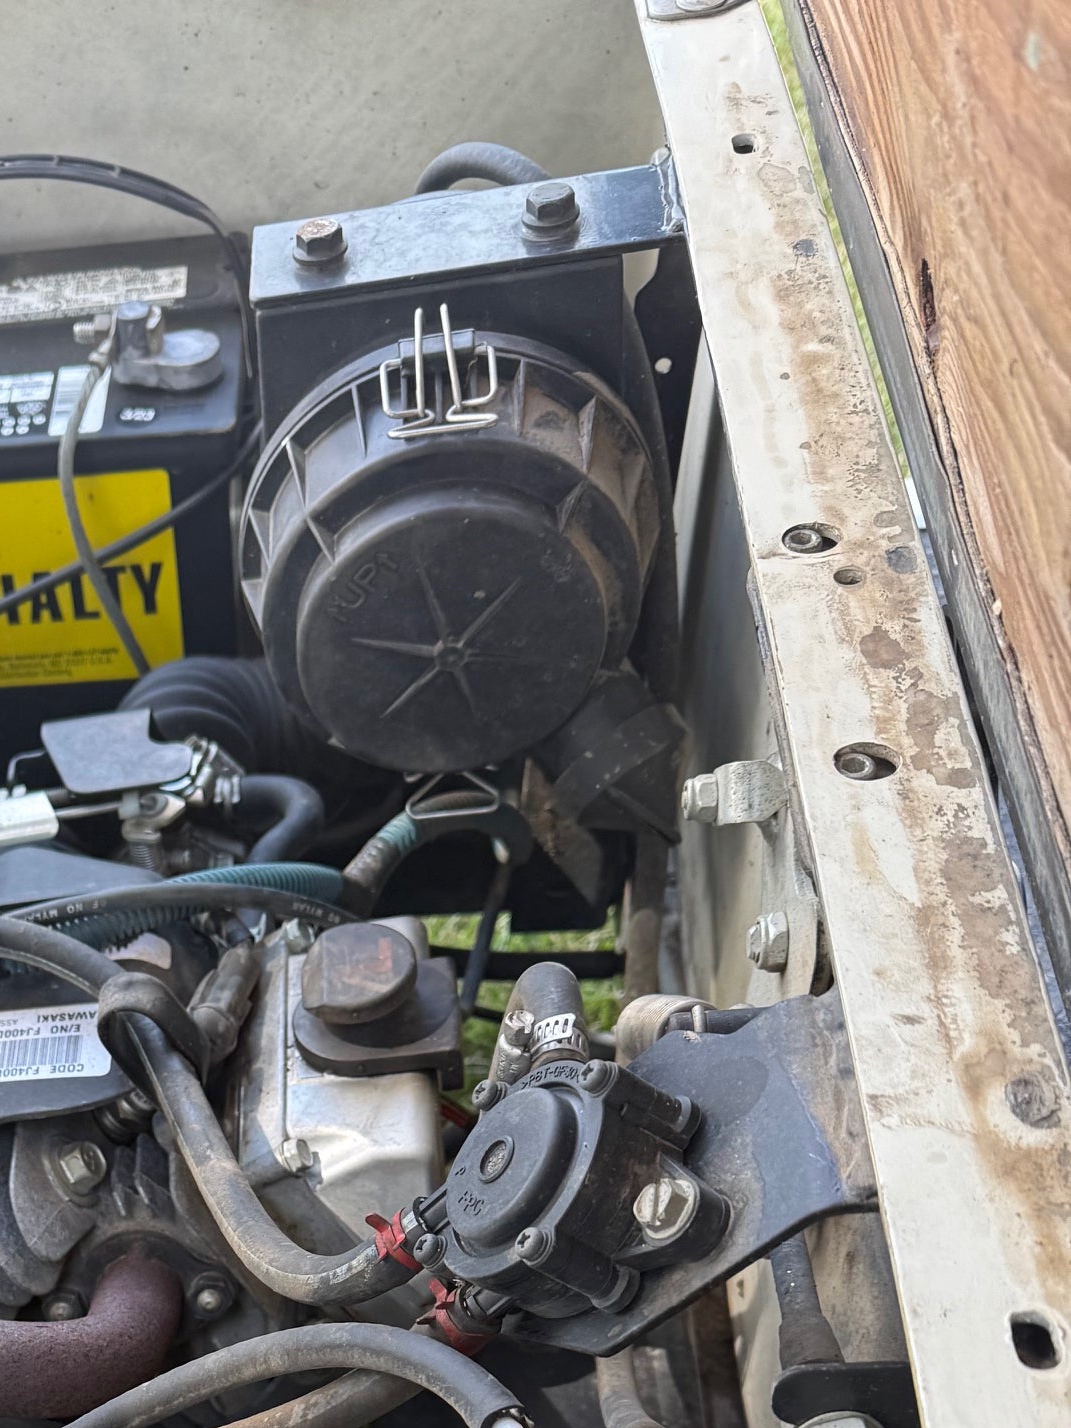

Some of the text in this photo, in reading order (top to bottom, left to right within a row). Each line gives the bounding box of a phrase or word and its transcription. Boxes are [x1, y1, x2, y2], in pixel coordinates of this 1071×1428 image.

[36, 1009, 98, 1023] AWASAKI
[50, 1023, 81, 1034] E/NO
[49, 1063, 84, 1074] CODE
